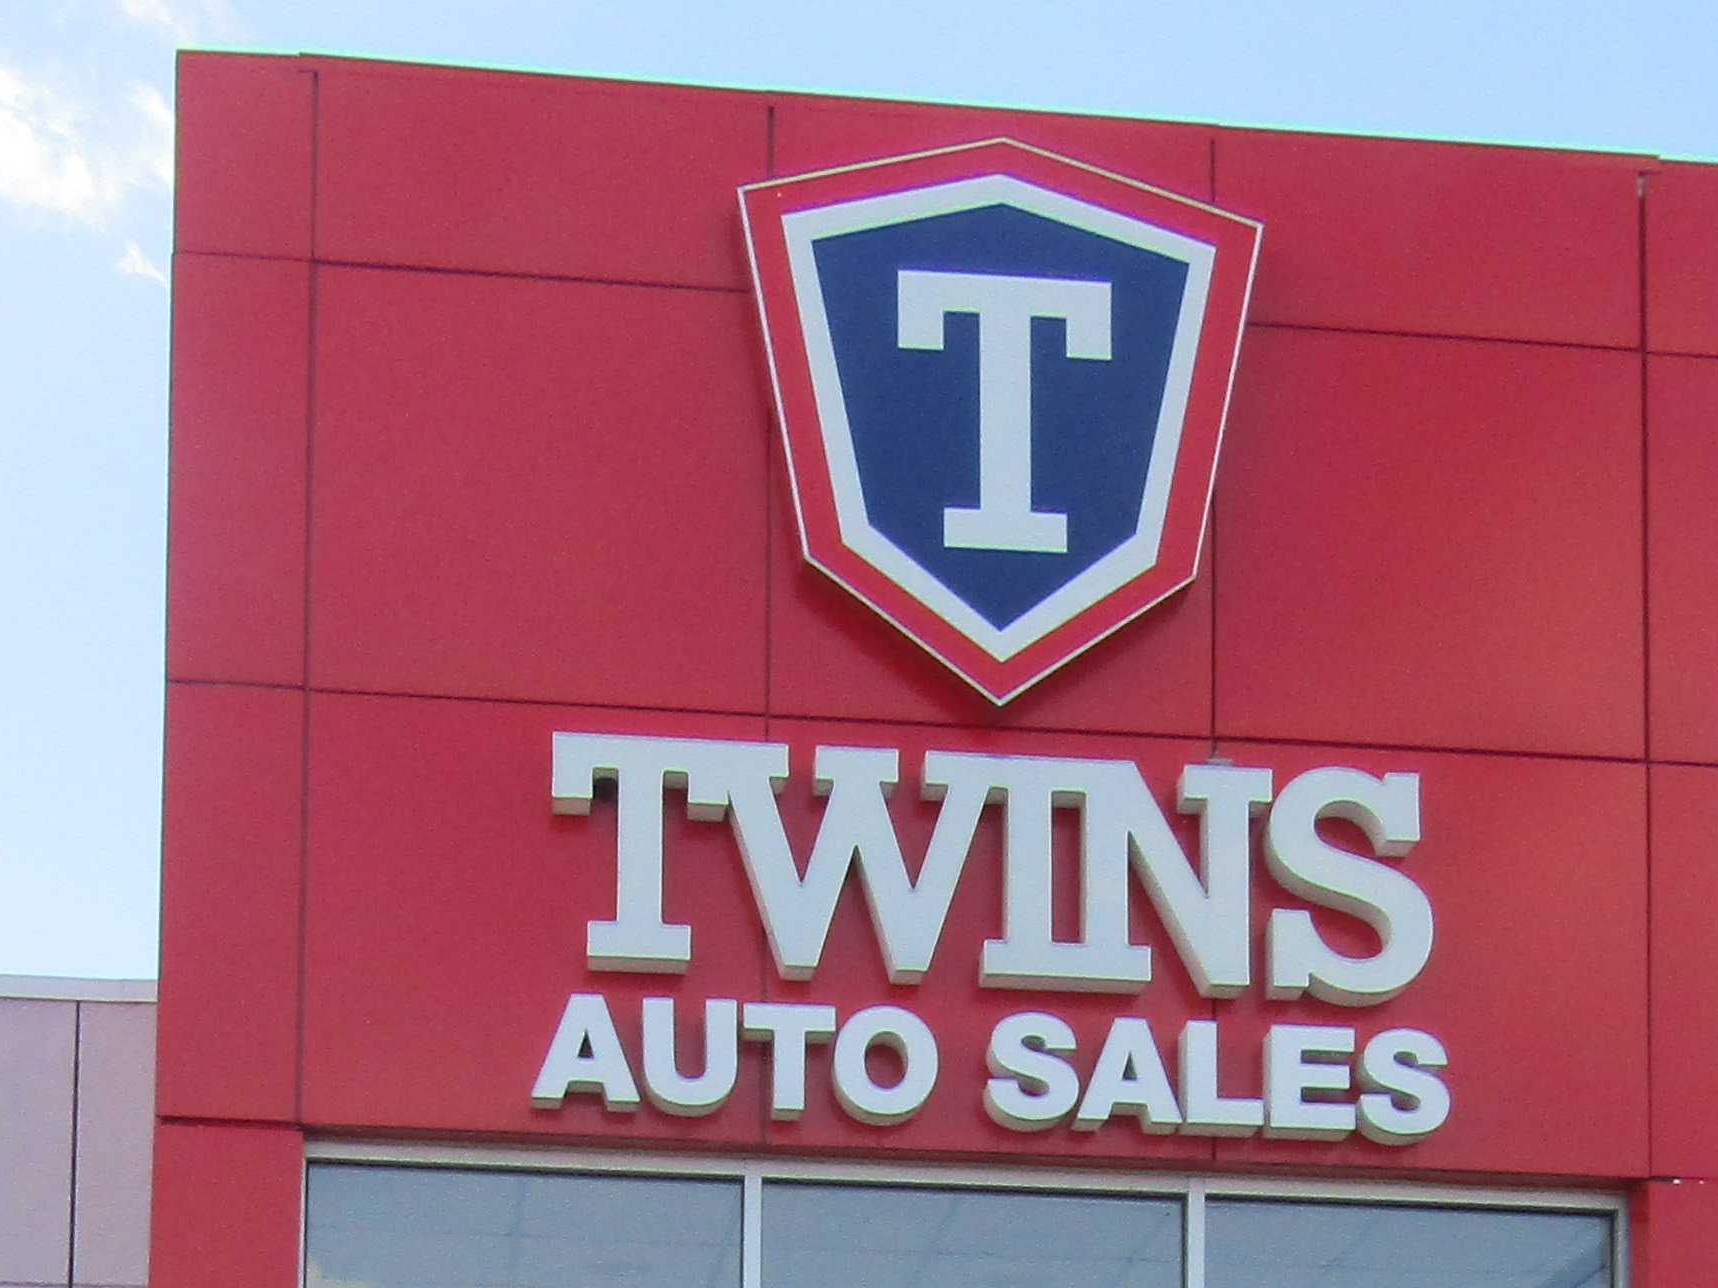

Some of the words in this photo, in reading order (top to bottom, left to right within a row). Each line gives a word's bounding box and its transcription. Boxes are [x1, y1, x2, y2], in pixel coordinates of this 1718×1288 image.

[898, 269, 1112, 553] T
[552, 731, 1434, 1006] TWINS
[531, 993, 939, 1125] AUTO
[983, 1011, 1451, 1146] SALES
